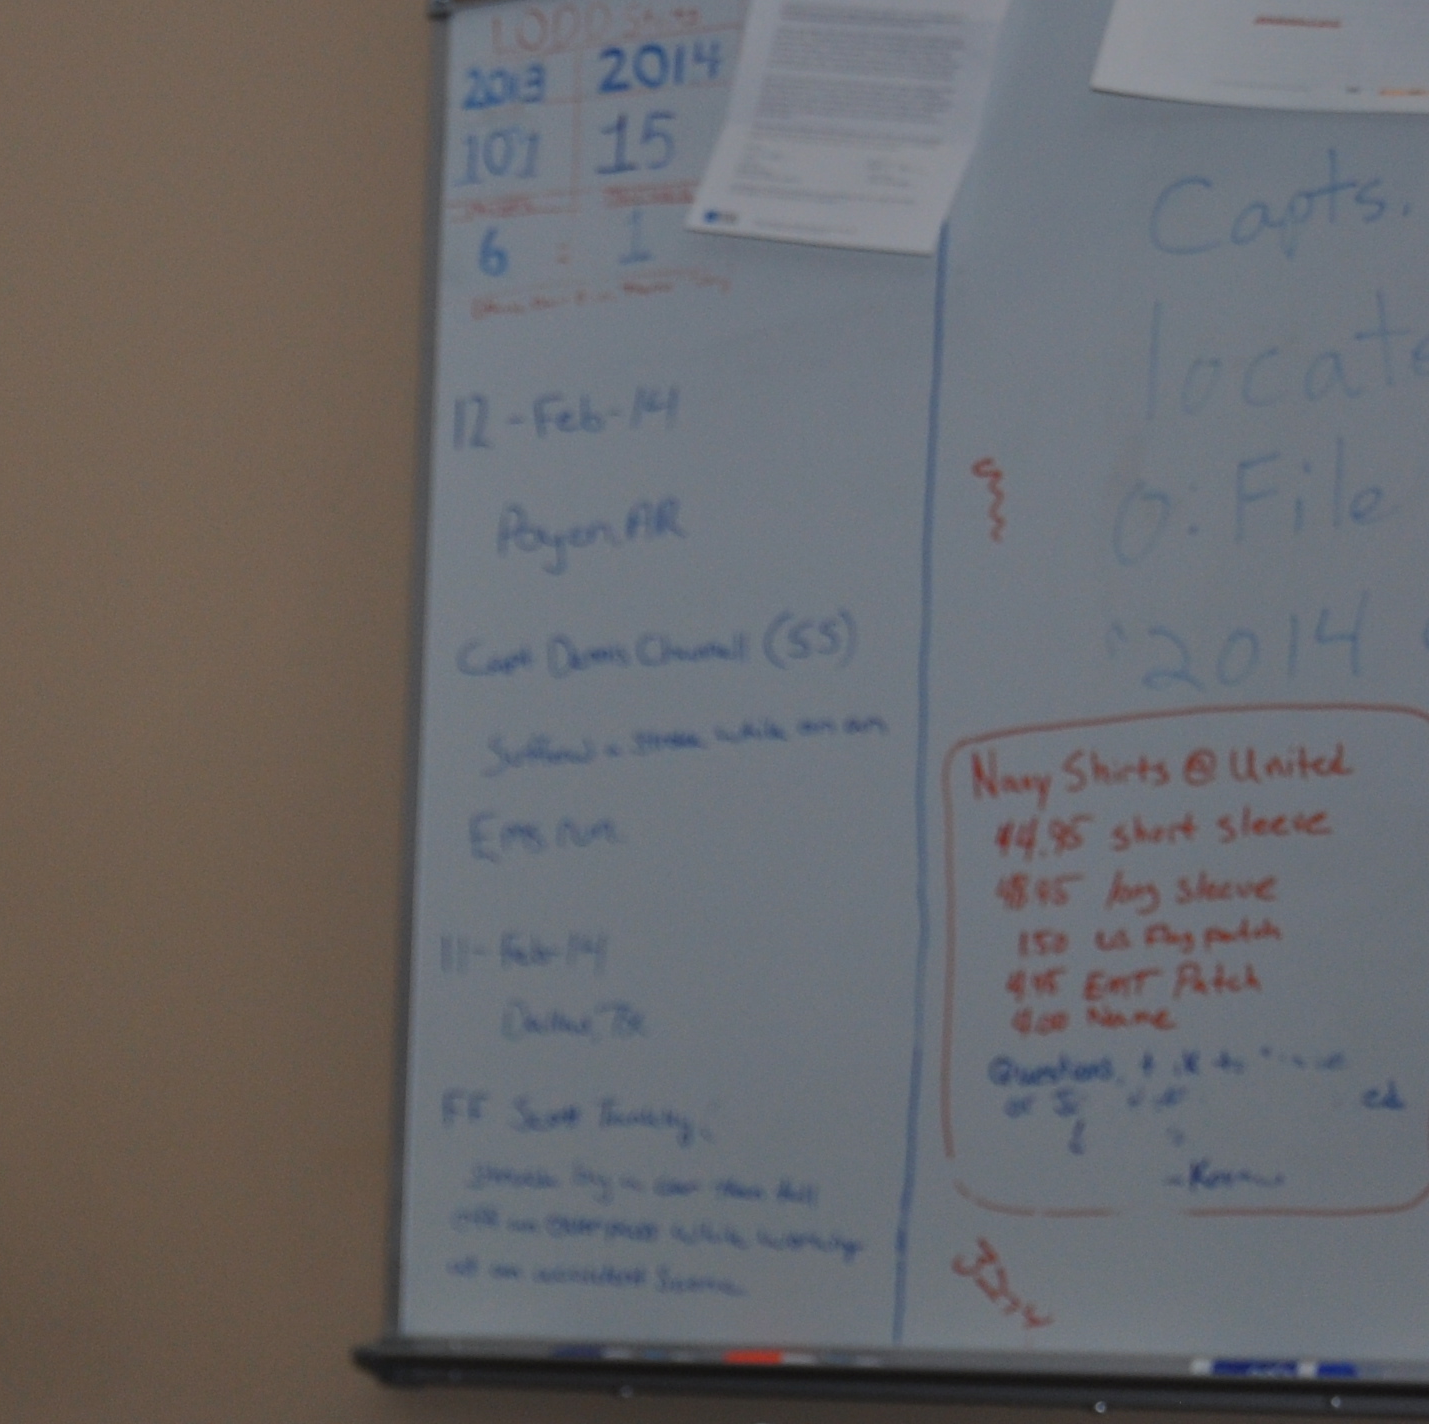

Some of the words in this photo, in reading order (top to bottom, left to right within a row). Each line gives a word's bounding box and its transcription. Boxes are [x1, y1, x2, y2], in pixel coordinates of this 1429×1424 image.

[461, 60, 546, 110] 2013
[597, 42, 722, 93] 2014
[594, 108, 678, 177] 15
[478, 226, 510, 278] 6
[1063, 746, 1171, 794] Shirts
[1228, 741, 1355, 785] United
[1215, 806, 1335, 846] sleeve
